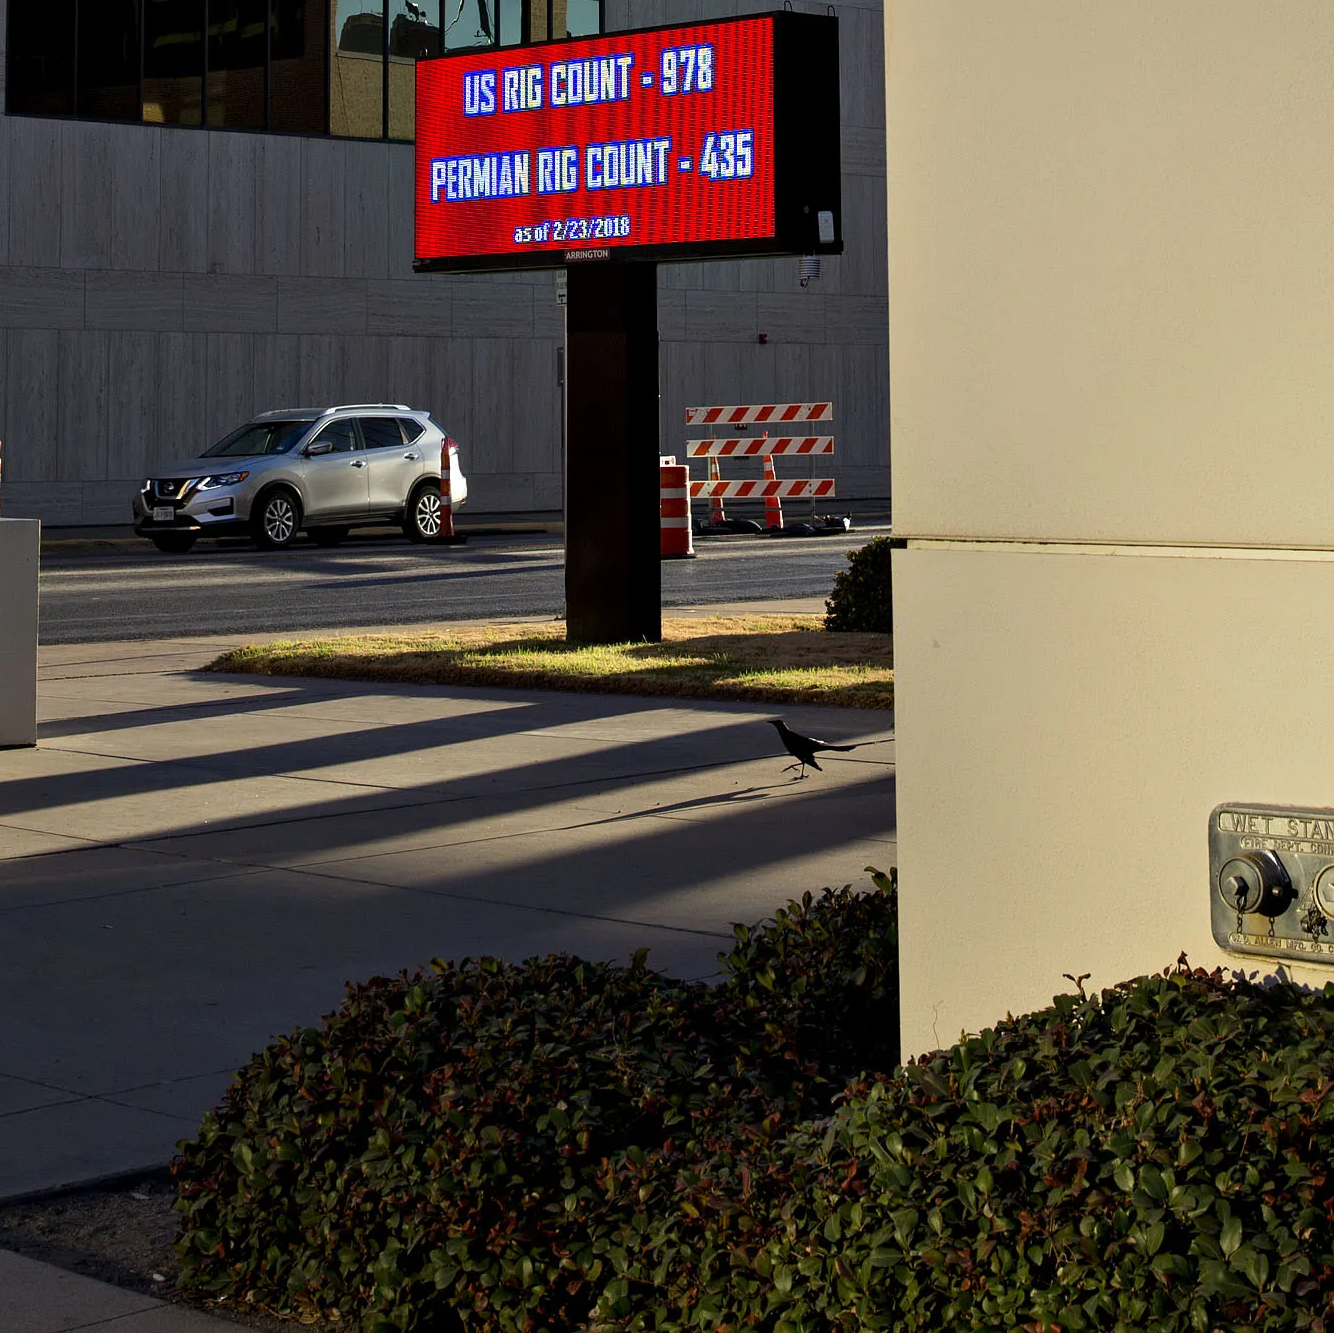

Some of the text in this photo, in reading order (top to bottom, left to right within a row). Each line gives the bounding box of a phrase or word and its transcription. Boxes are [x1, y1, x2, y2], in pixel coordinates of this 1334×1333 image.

[463, 69, 496, 117] US
[501, 63, 543, 113] RIG
[549, 52, 635, 108] COUNT
[659, 42, 715, 96] 978
[430, 149, 531, 203] PERMIAN
[536, 144, 579, 196] RIG
[585, 136, 672, 191] COUNT
[699, 128, 754, 182] 435
[513, 214, 631, 243] as of 2/23/2018
[564, 249, 610, 261] ARRINGTON
[1230, 813, 1274, 834] WET
[1244, 837, 1268, 849] FIRE
[1254, 937, 1282, 948] ALLEN
